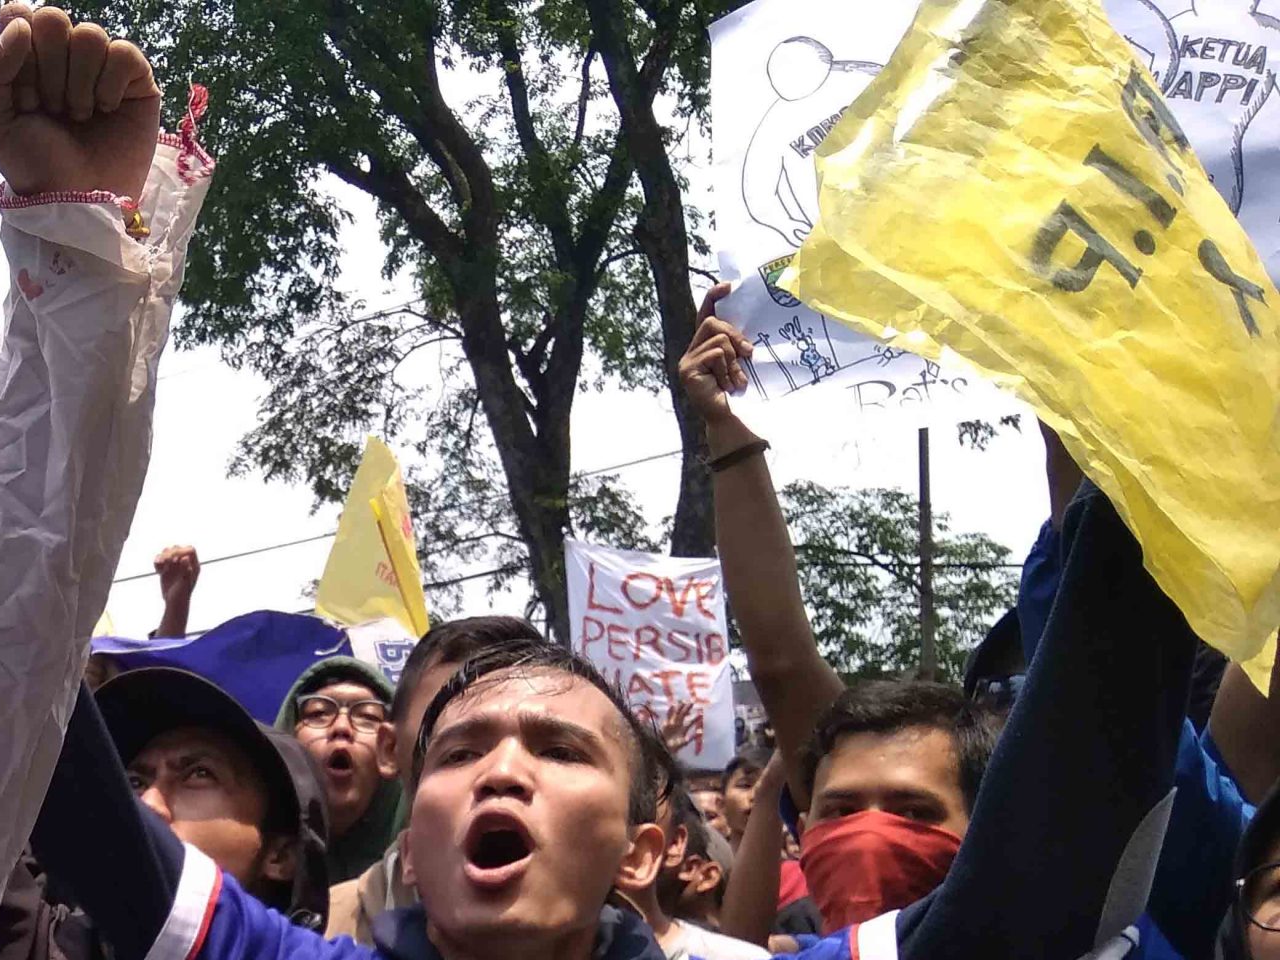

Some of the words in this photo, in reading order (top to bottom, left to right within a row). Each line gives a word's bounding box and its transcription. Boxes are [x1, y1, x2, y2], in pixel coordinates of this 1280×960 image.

[1178, 34, 1267, 75] KETUA
[1167, 71, 1260, 106] APPI
[588, 561, 716, 620] LOVE
[581, 615, 725, 666] PERSIB
